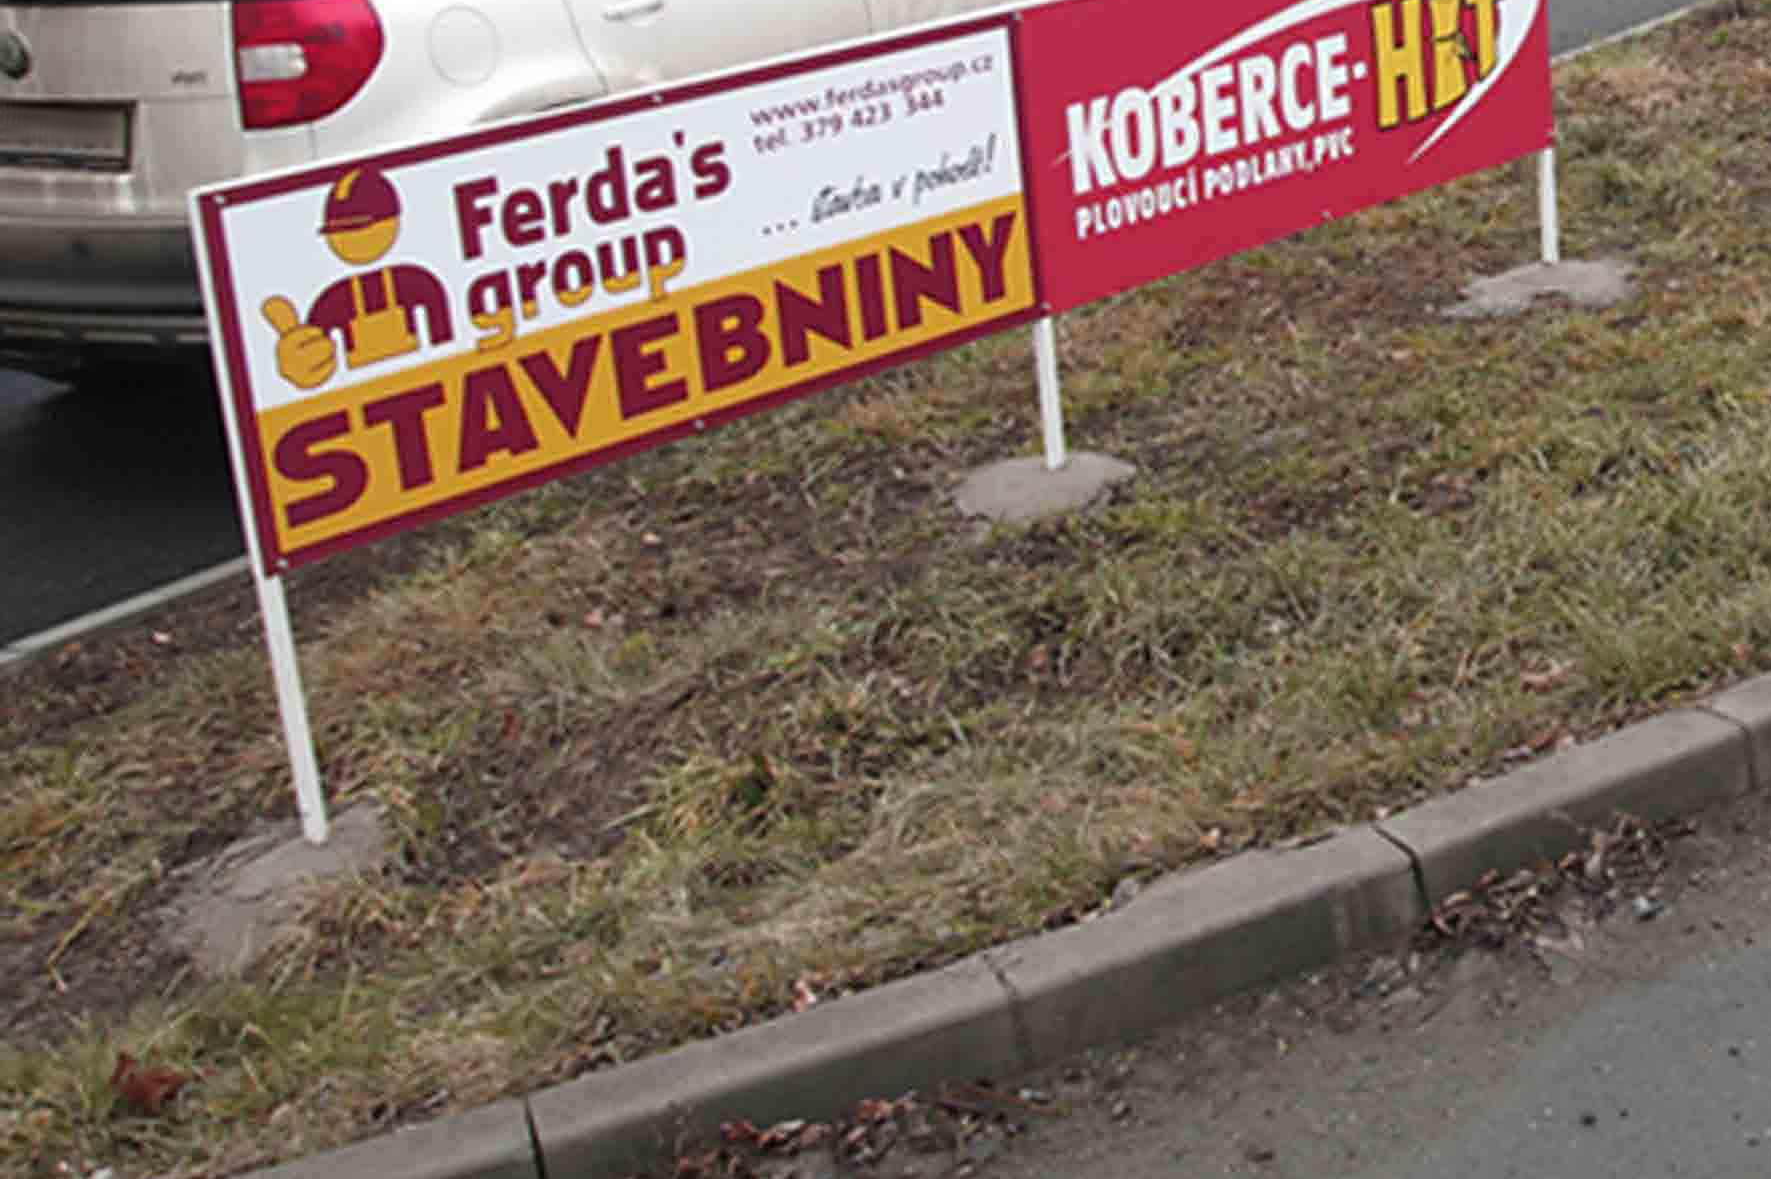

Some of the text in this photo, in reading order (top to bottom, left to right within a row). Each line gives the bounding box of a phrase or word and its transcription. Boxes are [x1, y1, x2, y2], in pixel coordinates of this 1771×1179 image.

[749, 55, 993, 126] www.ferdasgroup.cz
[801, 115, 843, 142] 379
[851, 101, 892, 127] 423
[906, 87, 944, 117] 344
[453, 131, 733, 261] Ferda's
[1075, 170, 1198, 241] PLOVOUCÍ
[467, 226, 688, 352] group
[270, 211, 1020, 531] STAVEBNINY
